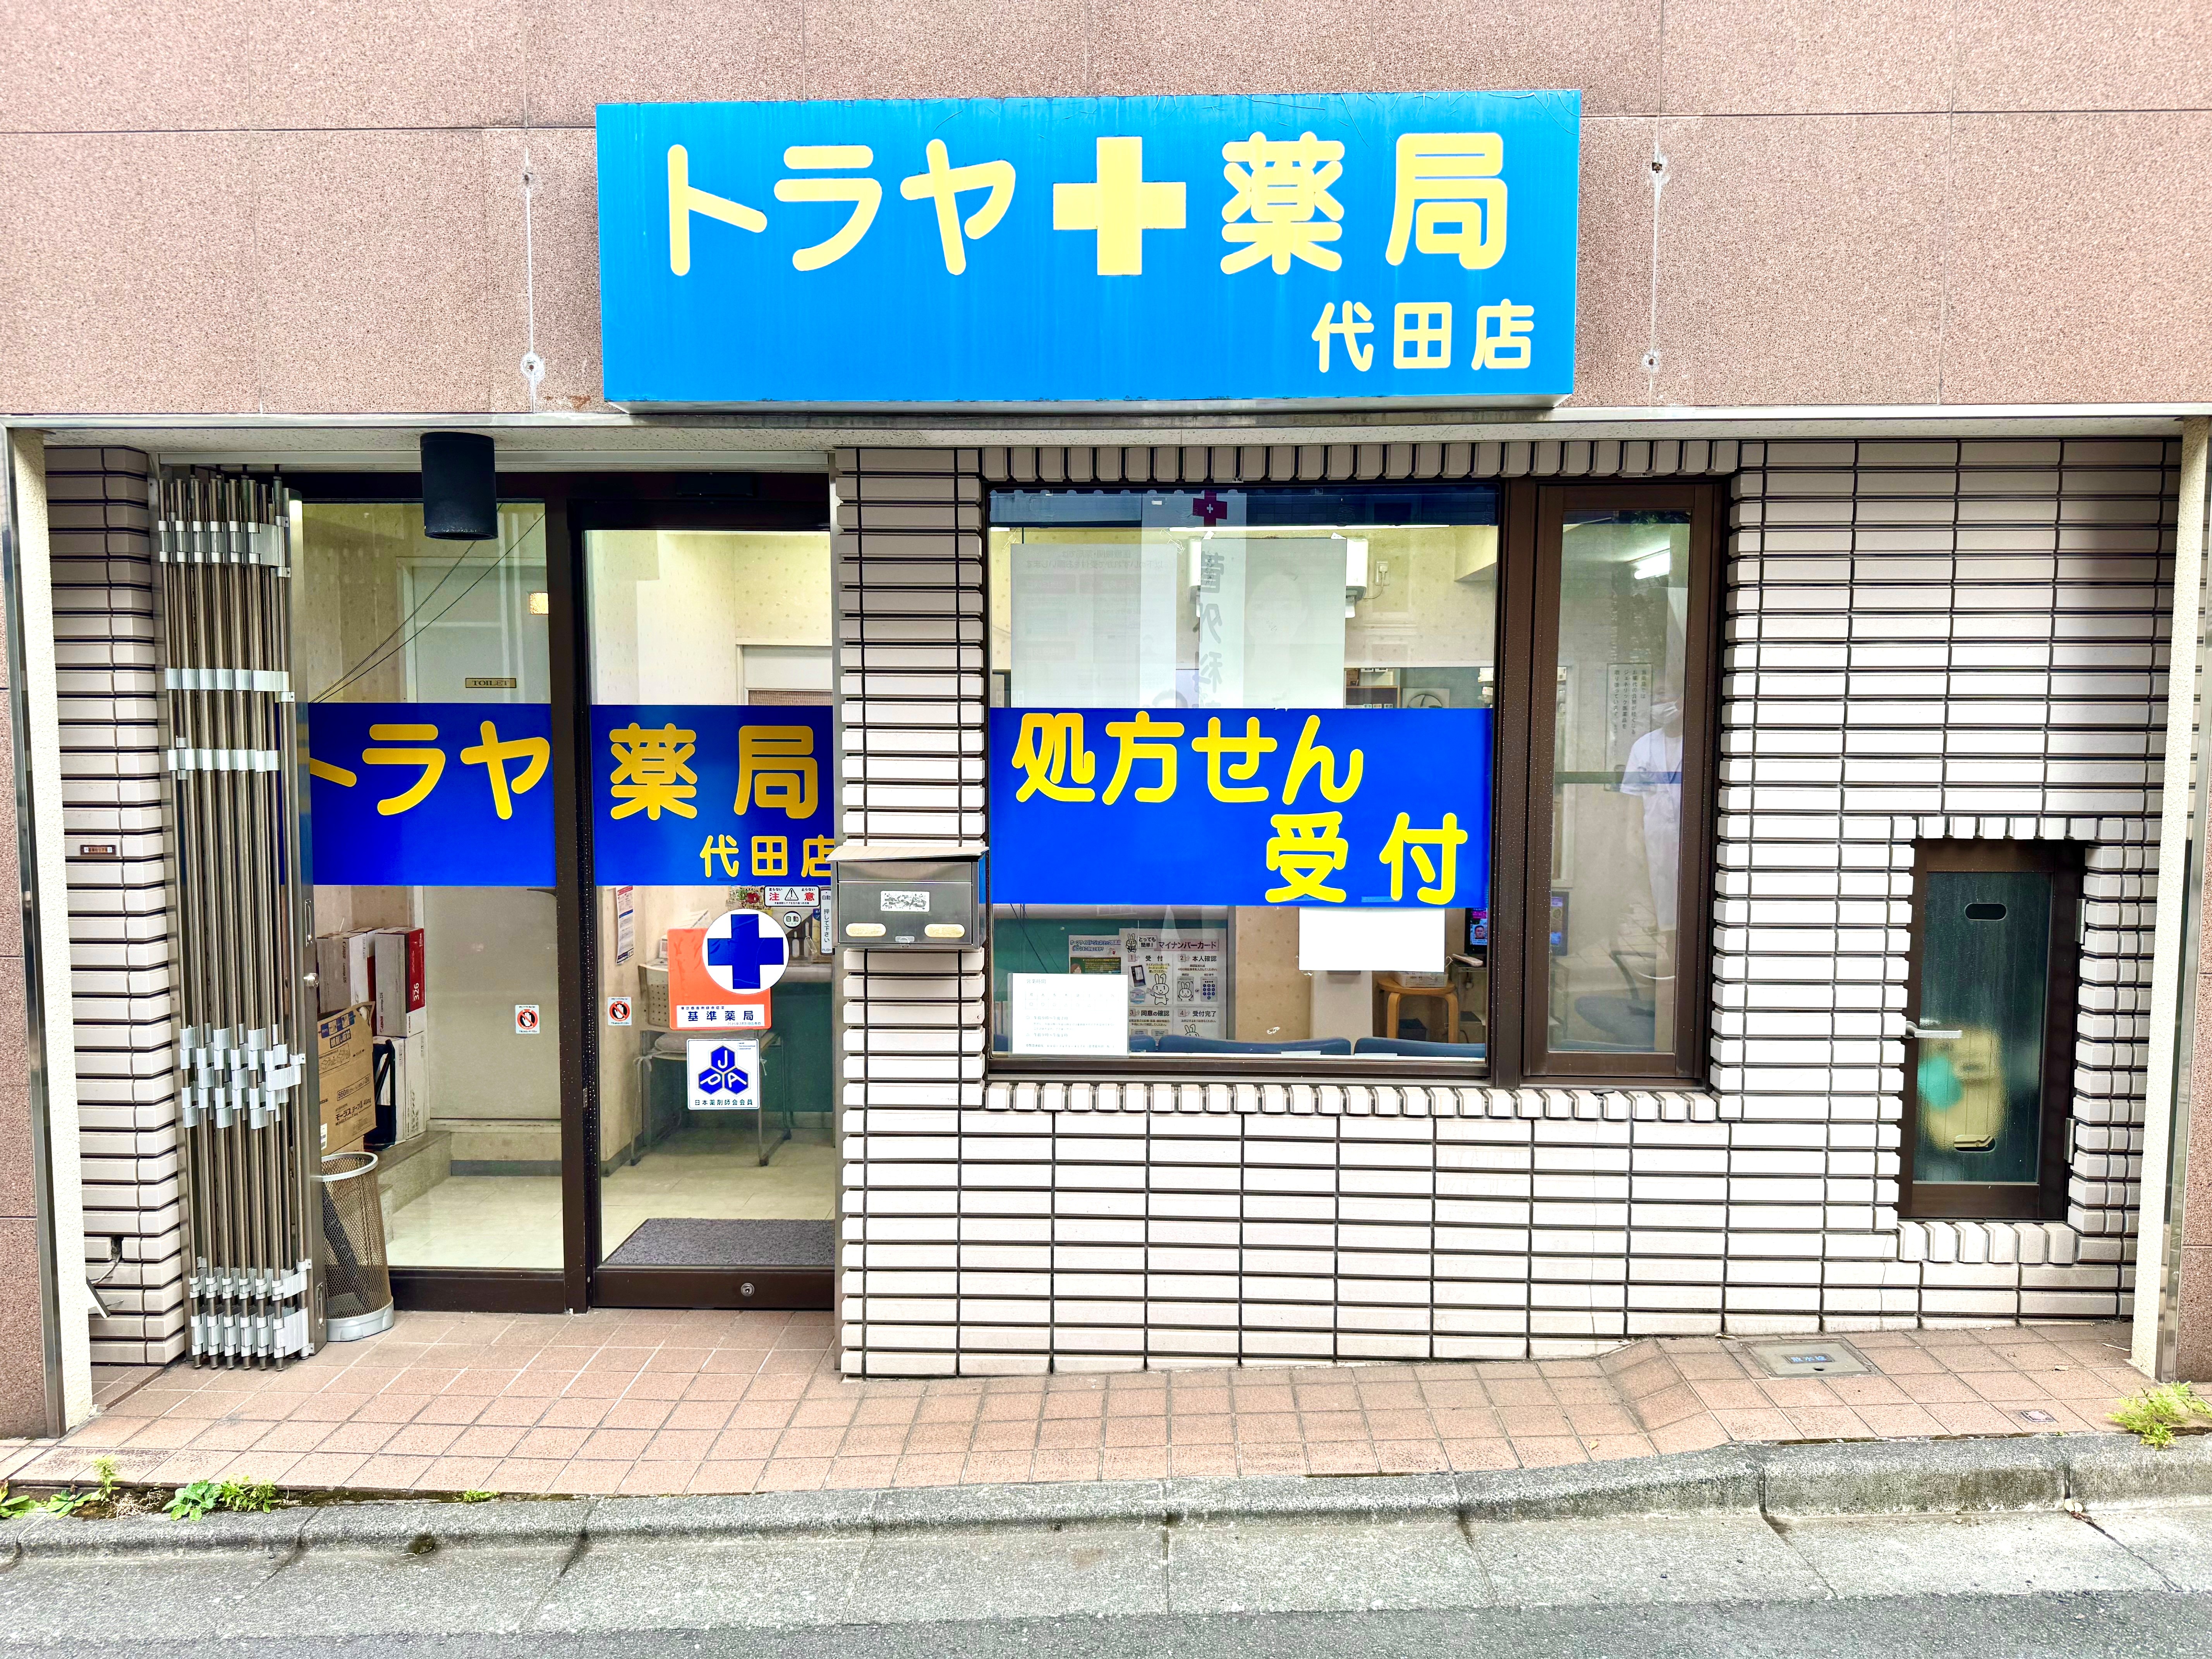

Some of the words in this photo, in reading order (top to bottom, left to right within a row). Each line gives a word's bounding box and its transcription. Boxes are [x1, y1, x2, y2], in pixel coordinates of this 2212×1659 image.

[668, 138, 1015, 276] トラヤ
[1221, 132, 1507, 275] 薬局
[1312, 299, 1534, 372] 代田店
[610, 723, 818, 821] 薬局
[1012, 711, 1364, 805] 処方せん
[1264, 811, 1468, 905] 受付
[688, 1010, 754, 1021] 基準薬局
